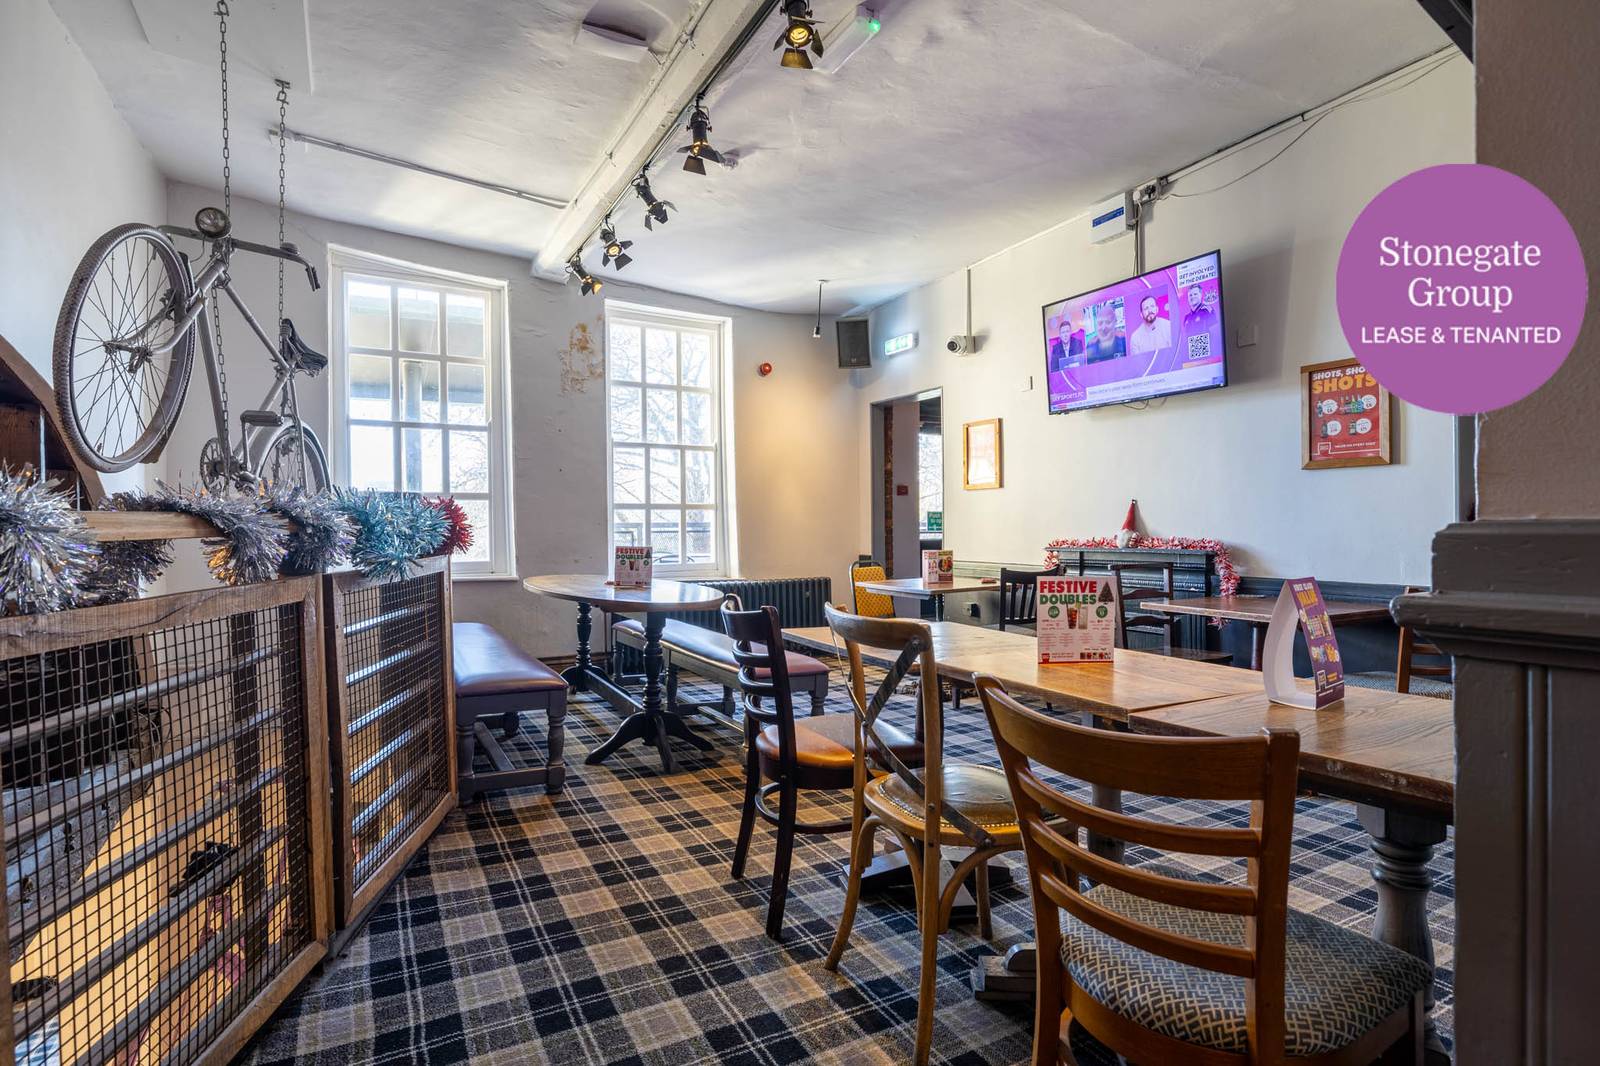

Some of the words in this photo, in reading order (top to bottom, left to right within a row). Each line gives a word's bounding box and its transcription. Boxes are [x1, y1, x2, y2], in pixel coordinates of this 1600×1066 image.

[1312, 369, 1343, 380] SHOTS,
[1345, 366, 1366, 375] SHO
[1312, 373, 1377, 393] SHOTS
[1040, 580, 1097, 593] FESTIVE
[1040, 594, 1097, 605] DOUBLES
